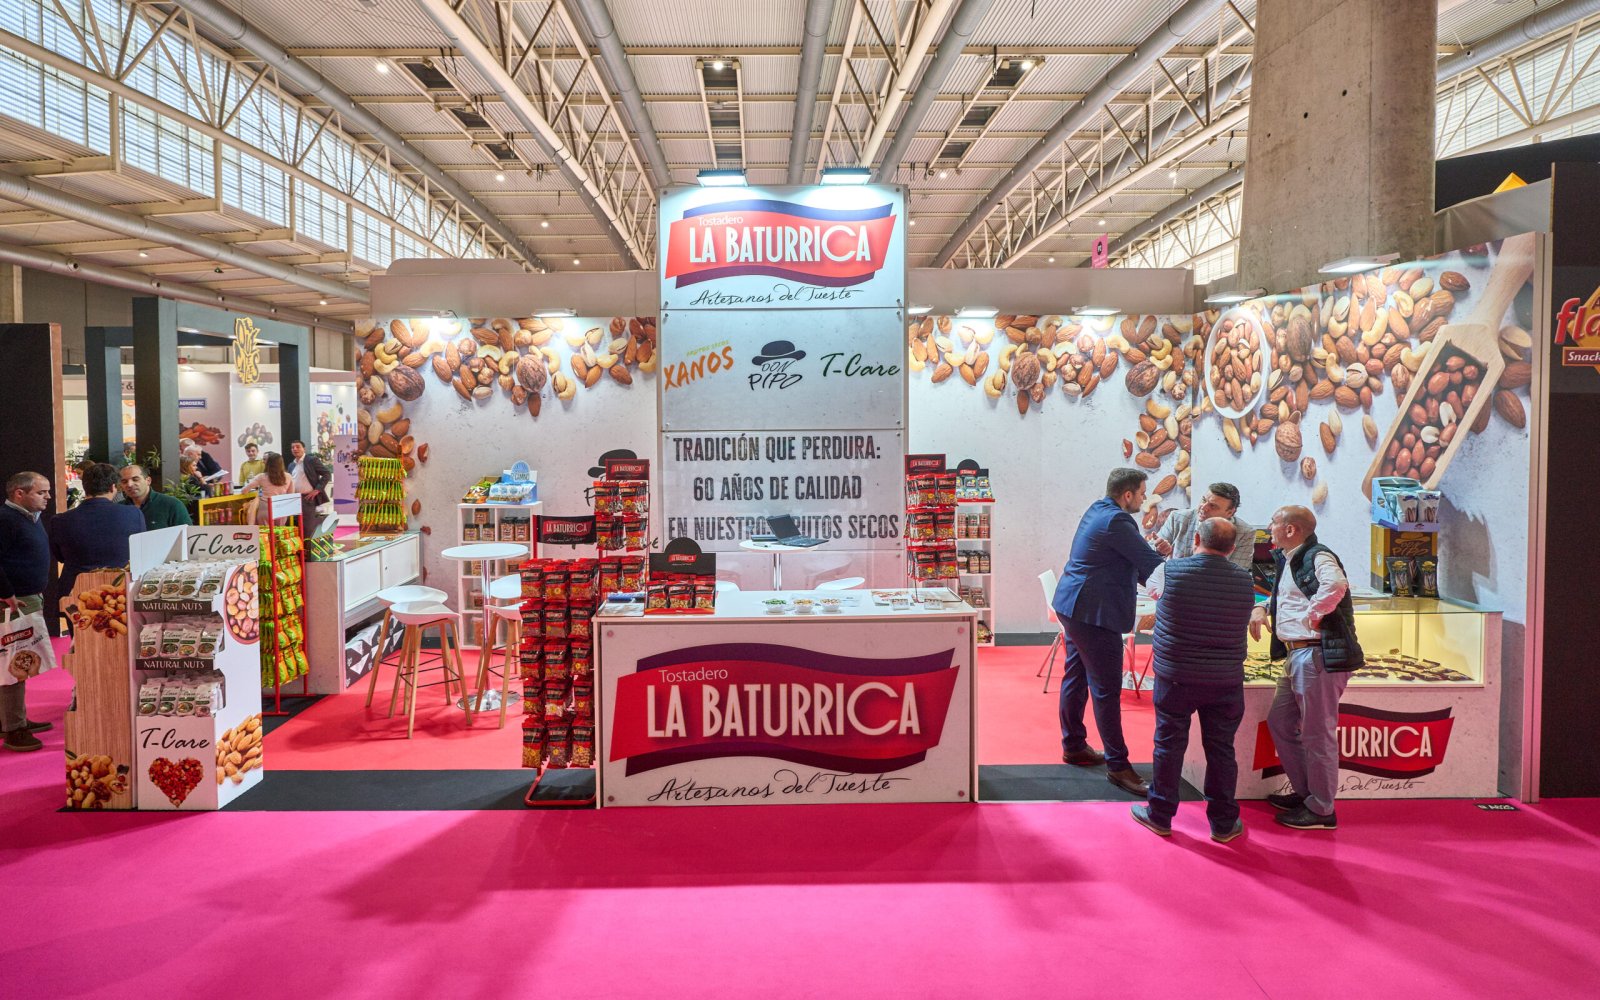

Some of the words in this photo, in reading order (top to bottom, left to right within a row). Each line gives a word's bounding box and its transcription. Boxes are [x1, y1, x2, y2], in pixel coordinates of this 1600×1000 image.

[698, 215, 744, 227] Tostadero
[689, 226, 717, 263] LA
[725, 225, 872, 262] BATURRICA
[690, 289, 774, 306] Artesanos
[773, 283, 803, 302] del
[806, 286, 864, 301] Tueste
[663, 345, 734, 392] XANOS
[761, 360, 797, 372] DON
[820, 352, 901, 377] T-Care
[748, 372, 803, 391] PIPO
[673, 433, 760, 462] TRADICIÓN
[765, 436, 796, 463] QUE
[802, 435, 881, 460] PERDURA:
[693, 476, 715, 501] 60
[720, 473, 764, 501] AÑOS
[770, 476, 789, 501] DE
[795, 475, 862, 500] CALIDAD
[546, 523, 552, 533] LA
[553, 523, 588, 533] BATURRICA
[668, 516, 688, 541] EN
[694, 515, 771, 541] NUESTRO
[848, 514, 899, 539] SECOS
[187, 533, 257, 555] T-Care
[142, 602, 179, 610] NATURAL
[182, 602, 203, 610] NUTS
[144, 660, 181, 669] NATURAL
[184, 660, 205, 669] NUTS
[658, 667, 729, 683] Tostadero
[647, 685, 688, 738] LA
[702, 681, 921, 737] BATURRICA
[140, 728, 210, 749] T-Care
[647, 777, 774, 802] Artesanos
[773, 768, 820, 795] del
[825, 771, 912, 795] Tueste
